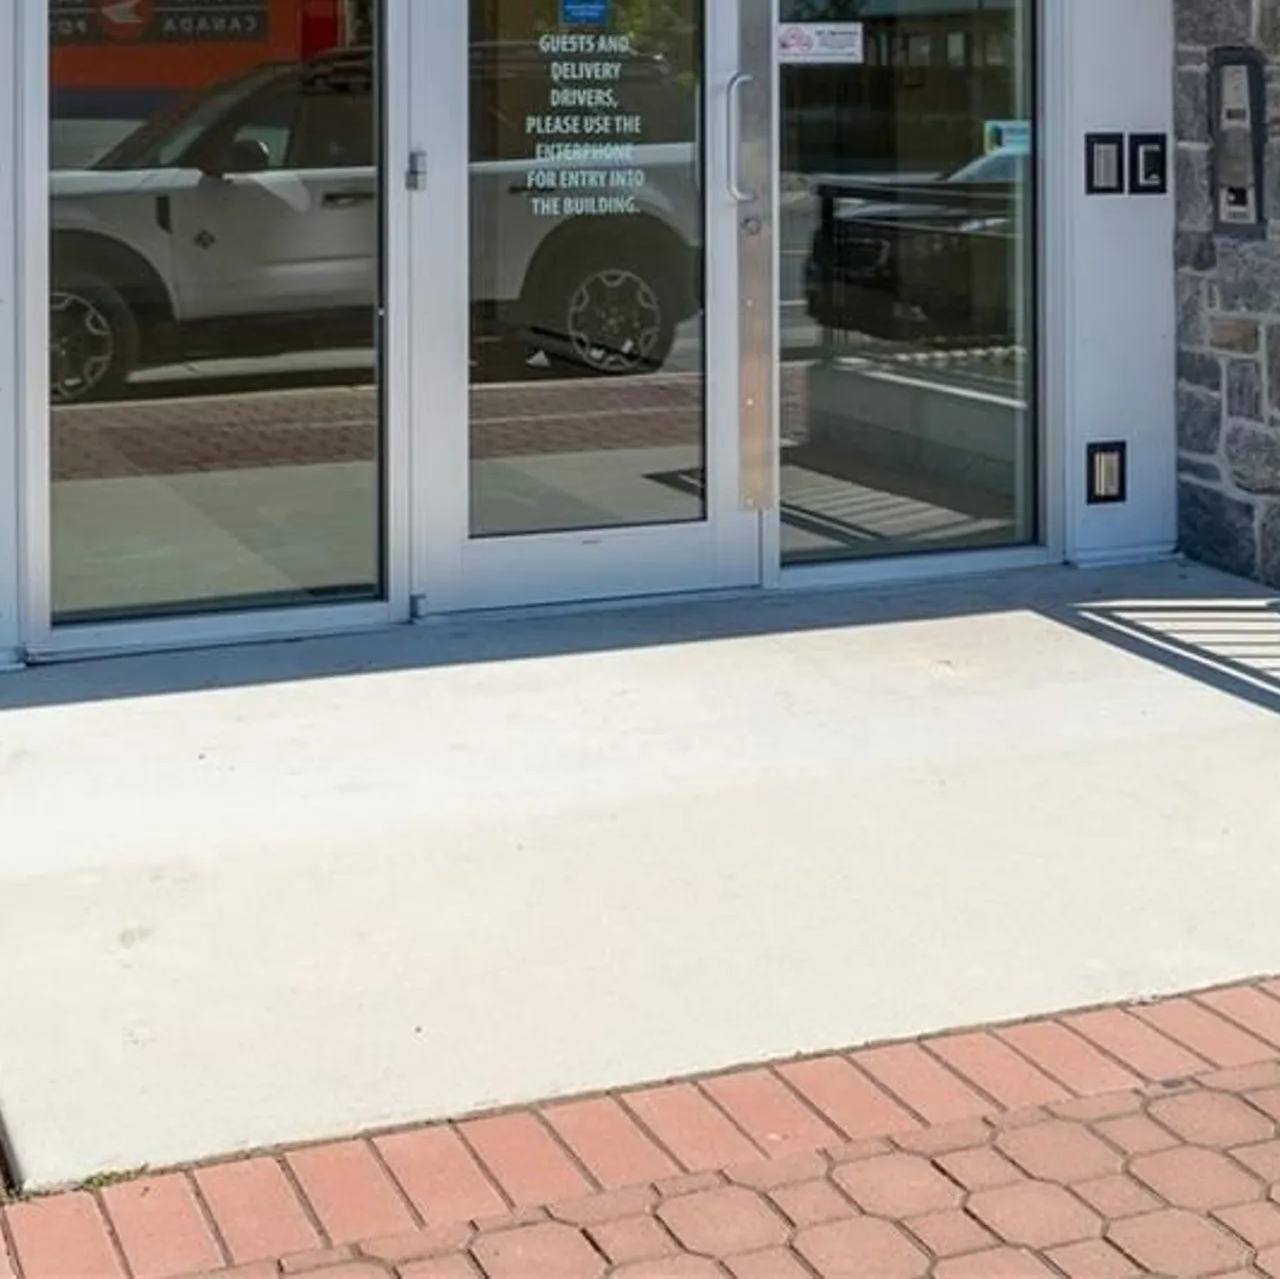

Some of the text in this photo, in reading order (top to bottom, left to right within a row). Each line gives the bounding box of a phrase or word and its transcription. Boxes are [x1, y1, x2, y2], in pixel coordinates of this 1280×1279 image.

[539, 33, 630, 53] GUESTS AND
[550, 61, 622, 81] DELIVERY
[550, 87, 619, 109] DRIVERS,
[524, 114, 642, 134] PLEASE USE THE
[526, 168, 645, 189] FOR ENTRY INTO
[531, 196, 561, 216] THE
